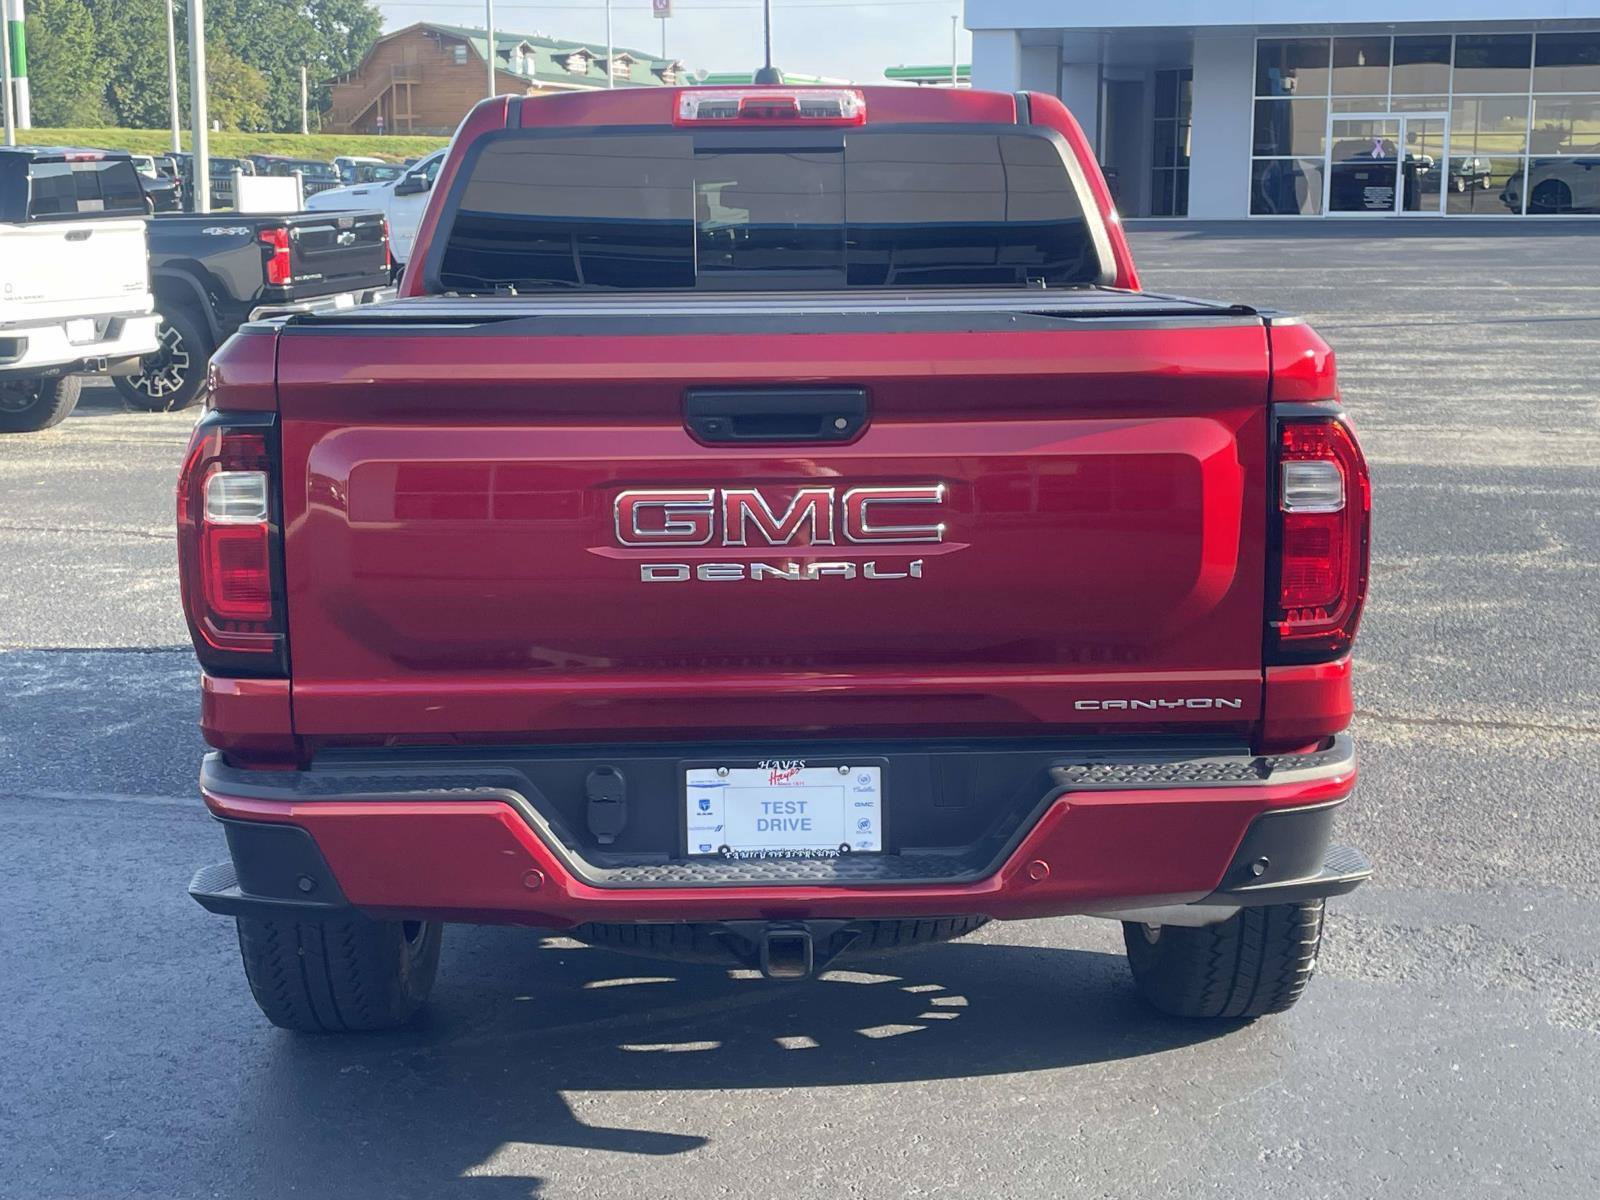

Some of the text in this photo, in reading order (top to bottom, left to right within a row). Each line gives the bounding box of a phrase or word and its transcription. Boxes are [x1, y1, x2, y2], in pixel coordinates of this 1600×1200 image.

[613, 484, 947, 547] GMC
[640, 559, 924, 583] DENALI
[1074, 698, 1242, 710] CANYON
[758, 759, 806, 769] HAYES
[760, 800, 808, 815] TEST
[757, 818, 813, 832] DRIVE
